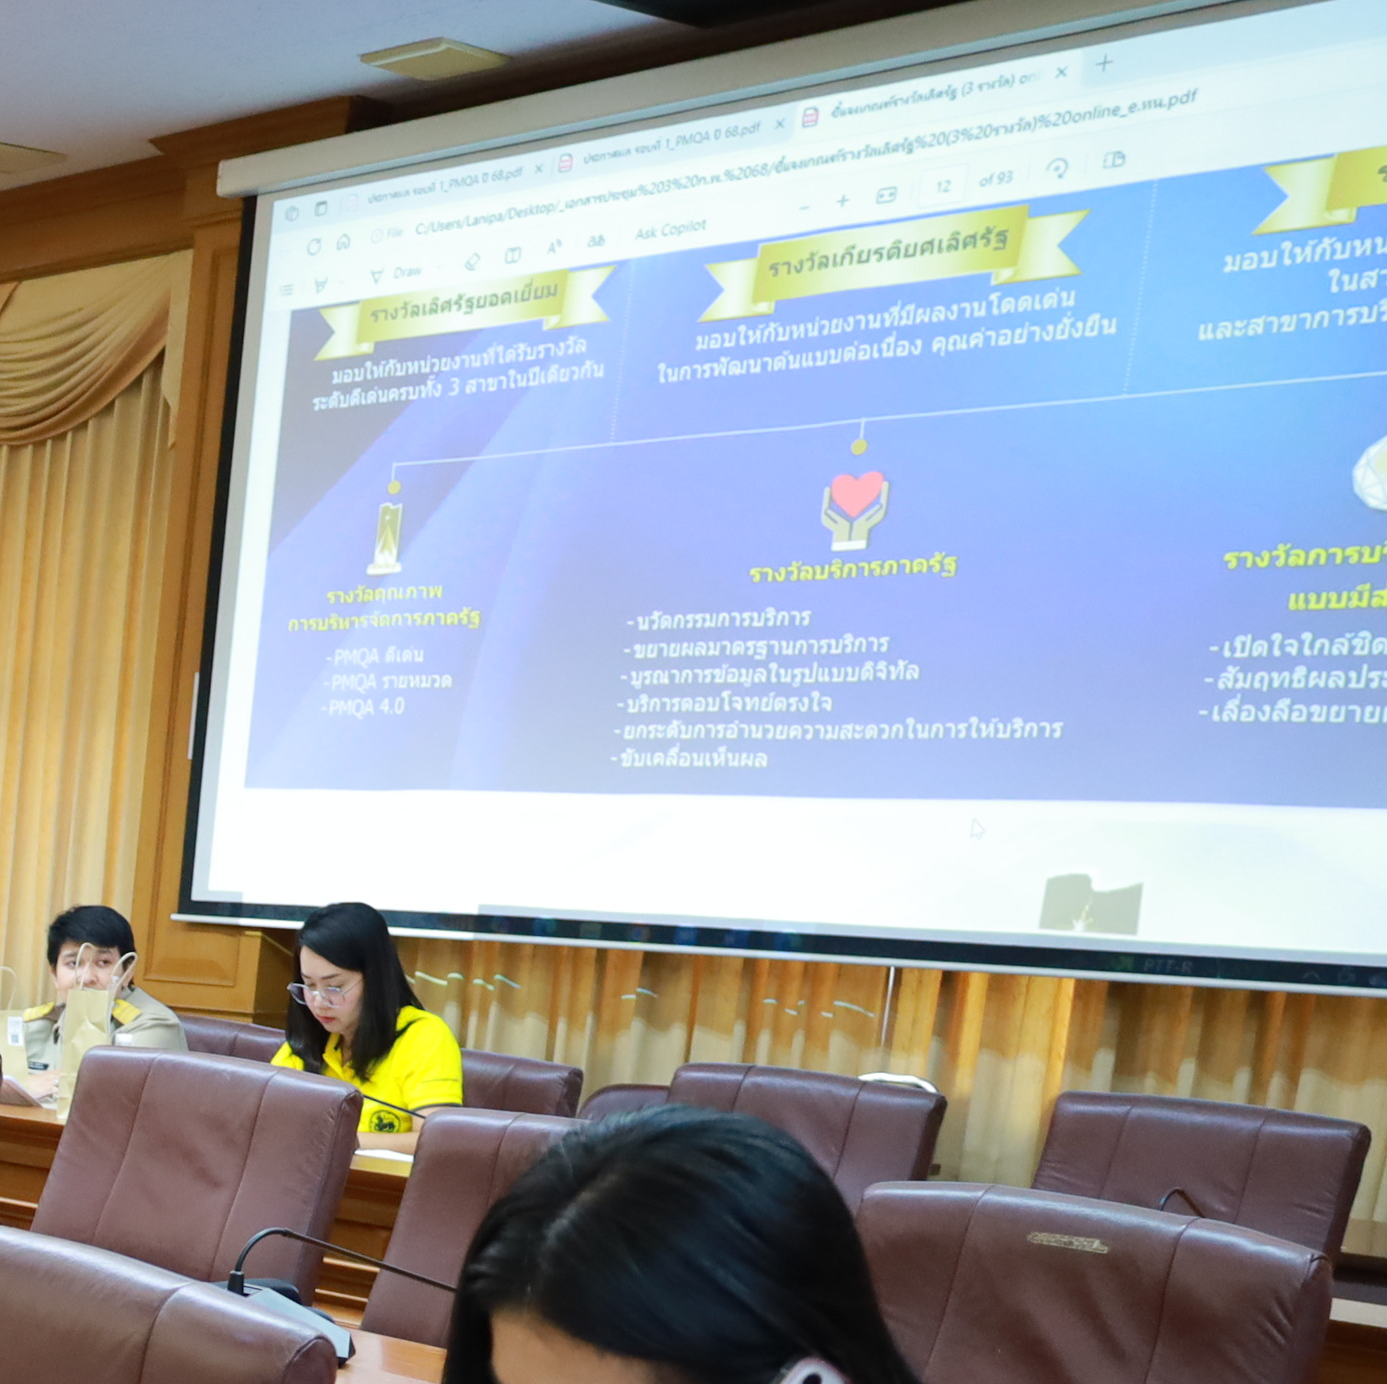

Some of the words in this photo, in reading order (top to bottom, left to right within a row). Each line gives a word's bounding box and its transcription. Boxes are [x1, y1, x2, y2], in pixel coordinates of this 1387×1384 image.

[724, 120, 762, 140] 68.pdf
[936, 180, 951, 194] 12
[979, 173, 994, 188] of
[996, 171, 1013, 186] 93
[635, 226, 657, 241] Ask
[661, 218, 707, 239] Copilot
[393, 265, 422, 280] Draw
[448, 378, 459, 397] 3
[750, 553, 958, 583] รางวัลบริการภาครัฐ
[379, 697, 405, 715] 4.0
